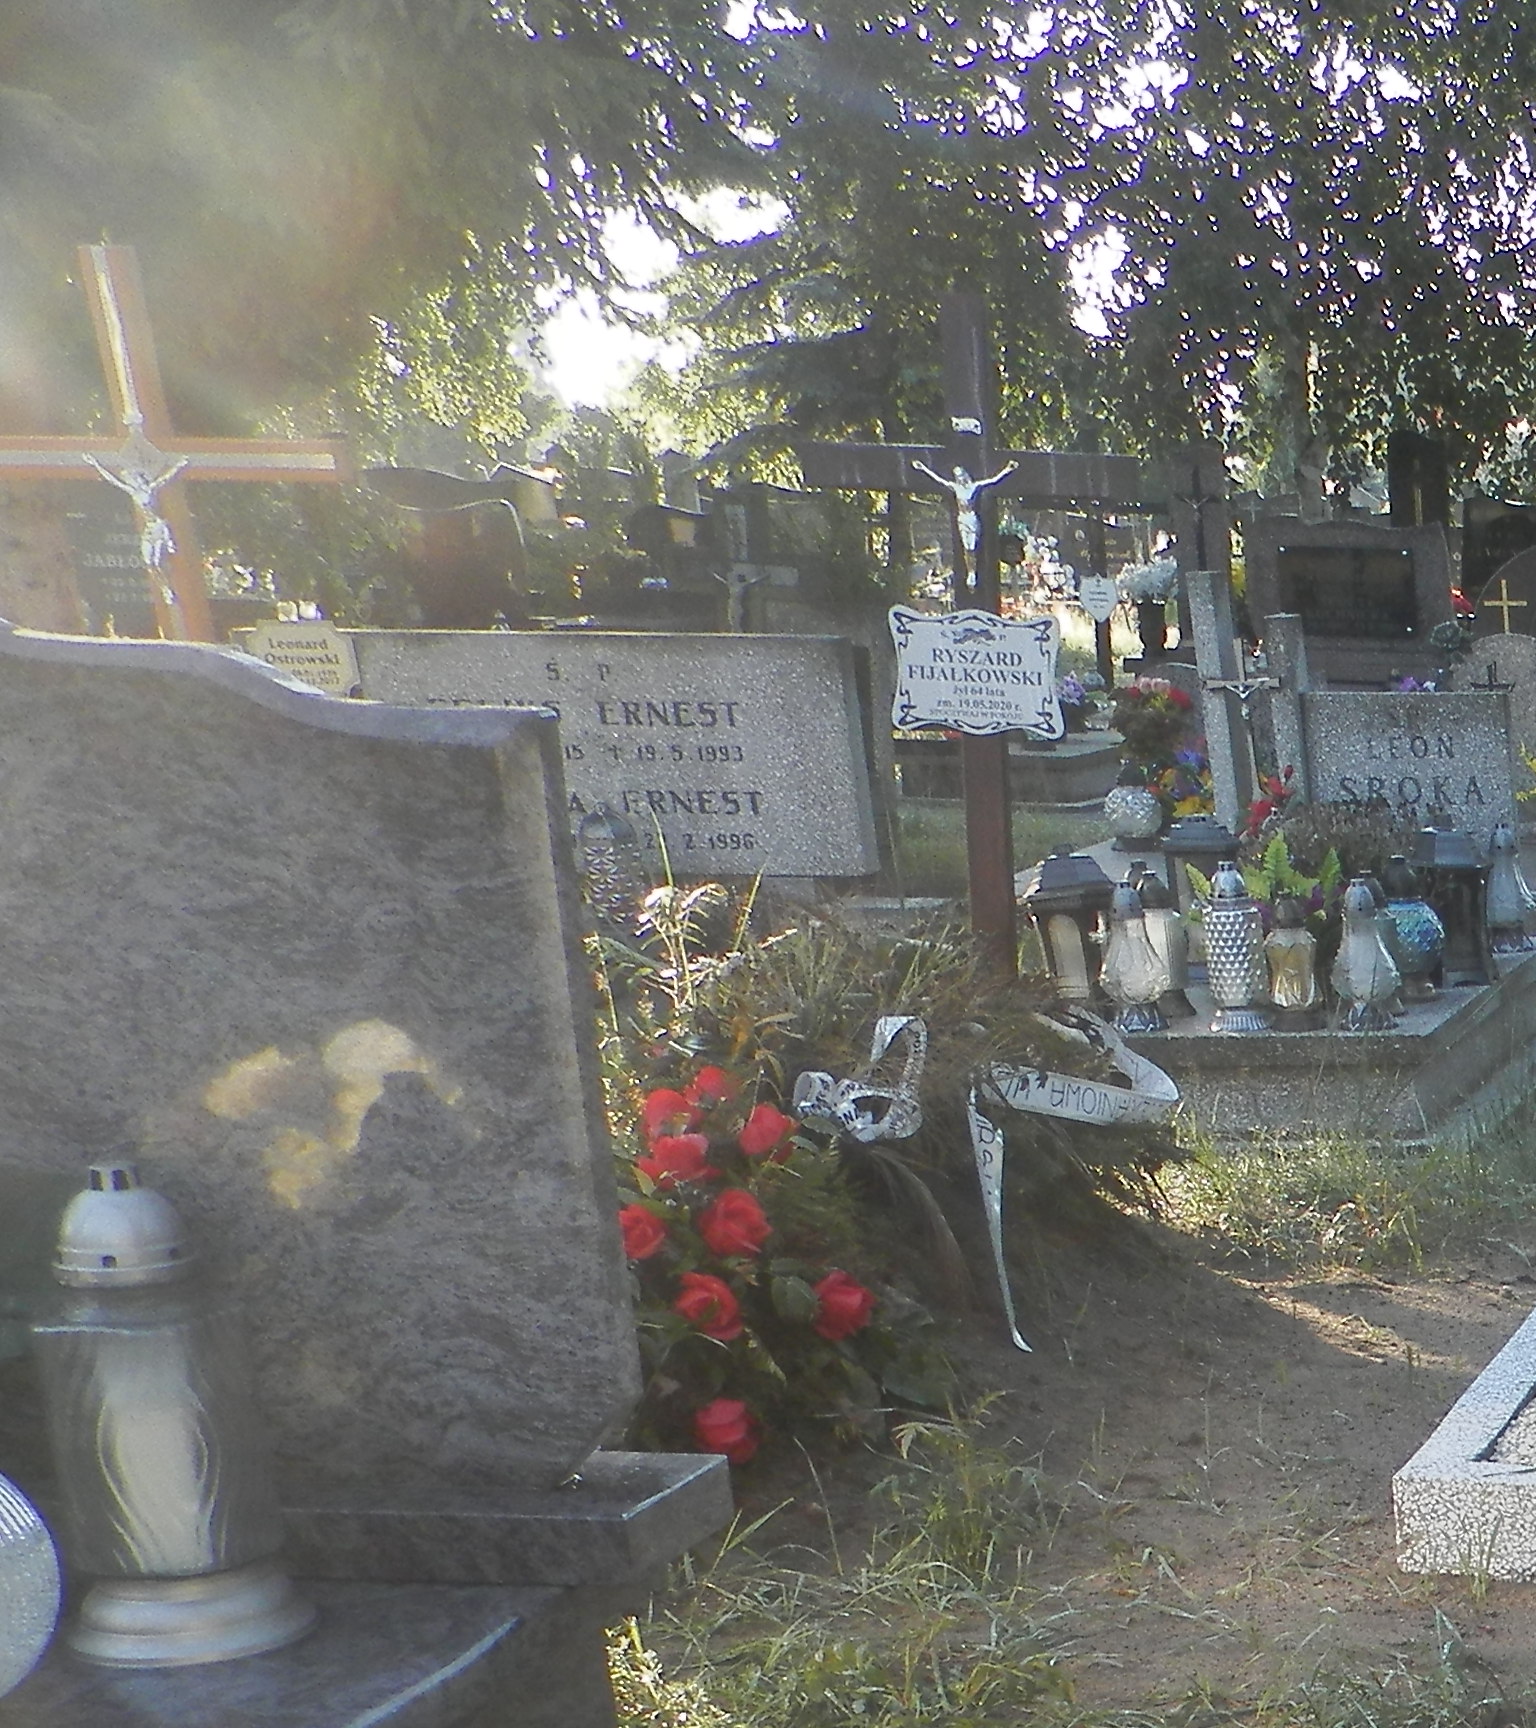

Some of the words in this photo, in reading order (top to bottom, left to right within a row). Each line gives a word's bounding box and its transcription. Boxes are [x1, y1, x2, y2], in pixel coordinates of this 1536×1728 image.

[268, 637, 329, 650] Leonard
[932, 648, 1023, 667] RYSZARD
[601, 701, 739, 728] ERNEST
[1366, 736, 1454, 760] LEON
[623, 791, 763, 817] ERNEST
[1340, 776, 1486, 807] SROKA
